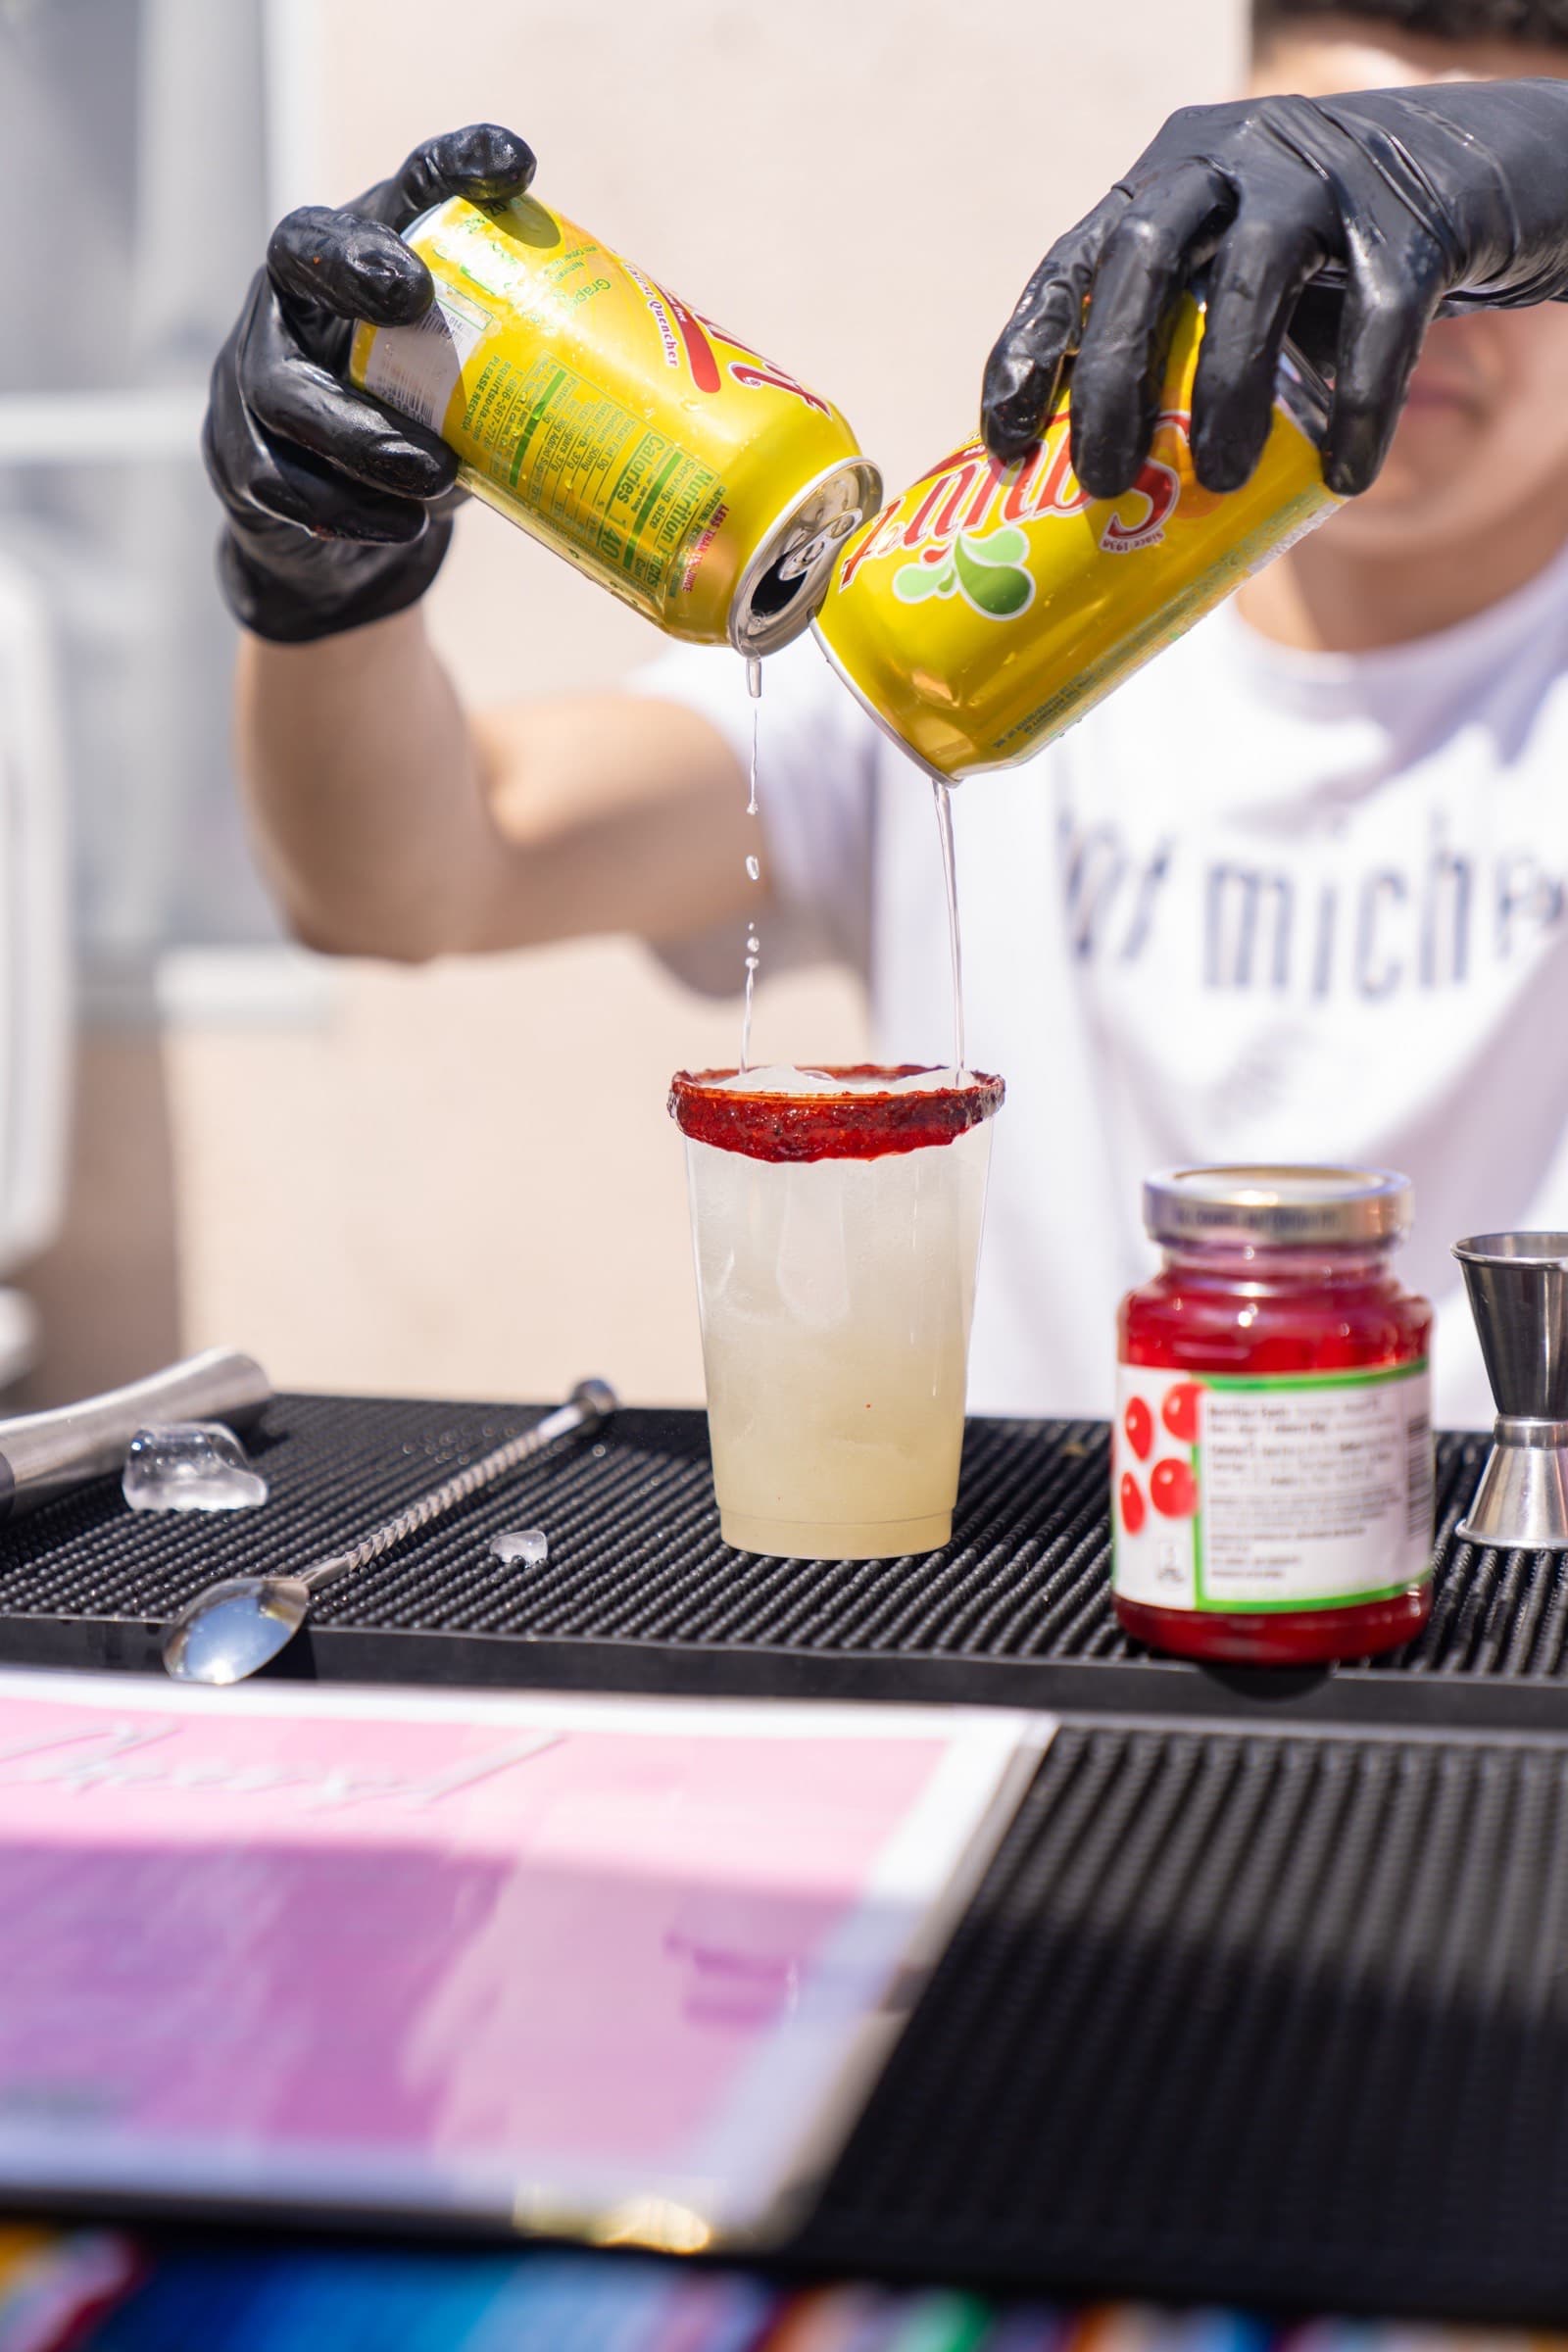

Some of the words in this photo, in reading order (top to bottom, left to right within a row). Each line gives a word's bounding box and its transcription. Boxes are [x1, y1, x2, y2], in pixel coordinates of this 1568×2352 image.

[648, 298, 677, 366] Quencher
[476, 355, 500, 390] PLEASE
[472, 362, 512, 441] squirtsoda.com
[551, 375, 576, 410] Protein
[592, 401, 612, 424] Total
[596, 408, 622, 444] Sodium
[542, 430, 560, 457] Added
[560, 423, 581, 453] Sugars
[579, 425, 596, 448] Carb.
[615, 417, 636, 440] Total
[550, 454, 564, 472] 37g
[565, 451, 581, 469] 37g
[579, 445, 599, 471] 50mg
[604, 440, 619, 457] Fat
[615, 433, 666, 505] Calories
[660, 459, 695, 502] Serving
[648, 503, 666, 529] size
[661, 469, 712, 544] Nutrition
[697, 484, 726, 522] CAFFEINE
[710, 503, 730, 527] LESS
[599, 515, 628, 559] 140
[644, 544, 672, 588] Facts
[681, 568, 697, 593] JUICE
